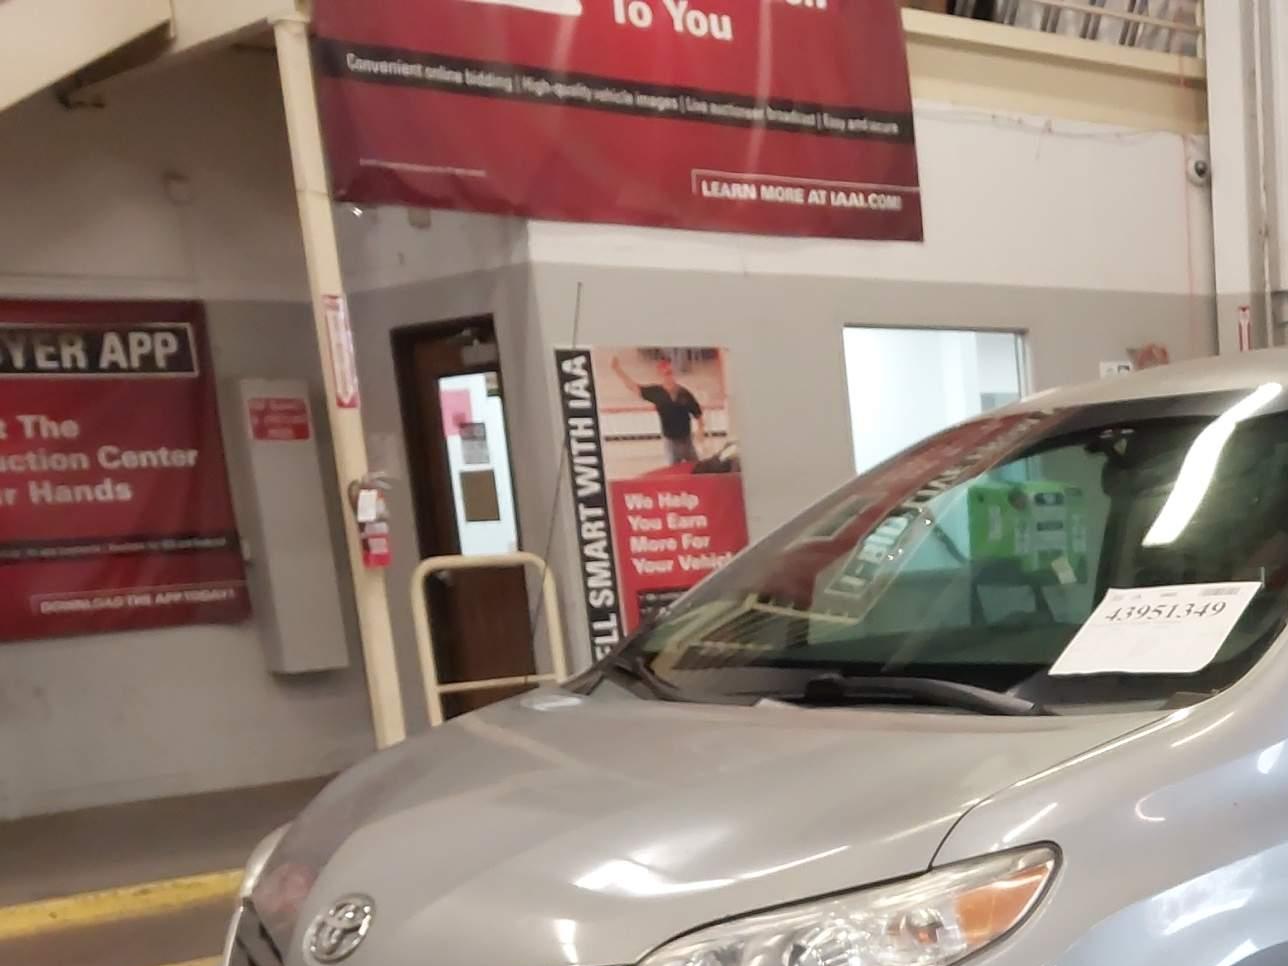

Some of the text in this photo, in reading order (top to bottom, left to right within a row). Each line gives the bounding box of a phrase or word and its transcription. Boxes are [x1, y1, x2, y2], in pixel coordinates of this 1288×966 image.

[613, 0, 732, 40] To You
[346, 53, 422, 78] Convenient
[701, 180, 756, 199] LEARN
[760, 185, 804, 204] MORE
[807, 190, 828, 205] AT
[0, 331, 178, 370] YER APP
[561, 354, 593, 409] IAA
[16, 414, 80, 439] The
[97, 445, 198, 470] Center
[567, 416, 601, 497] WITH
[27, 477, 134, 504] Hands
[624, 490, 699, 511] We Help
[627, 512, 707, 532] You Earn
[630, 532, 711, 553] More For
[578, 503, 615, 608] SMART
[631, 557, 674, 574] Your
[1105, 600, 1227, 622] 43951349
